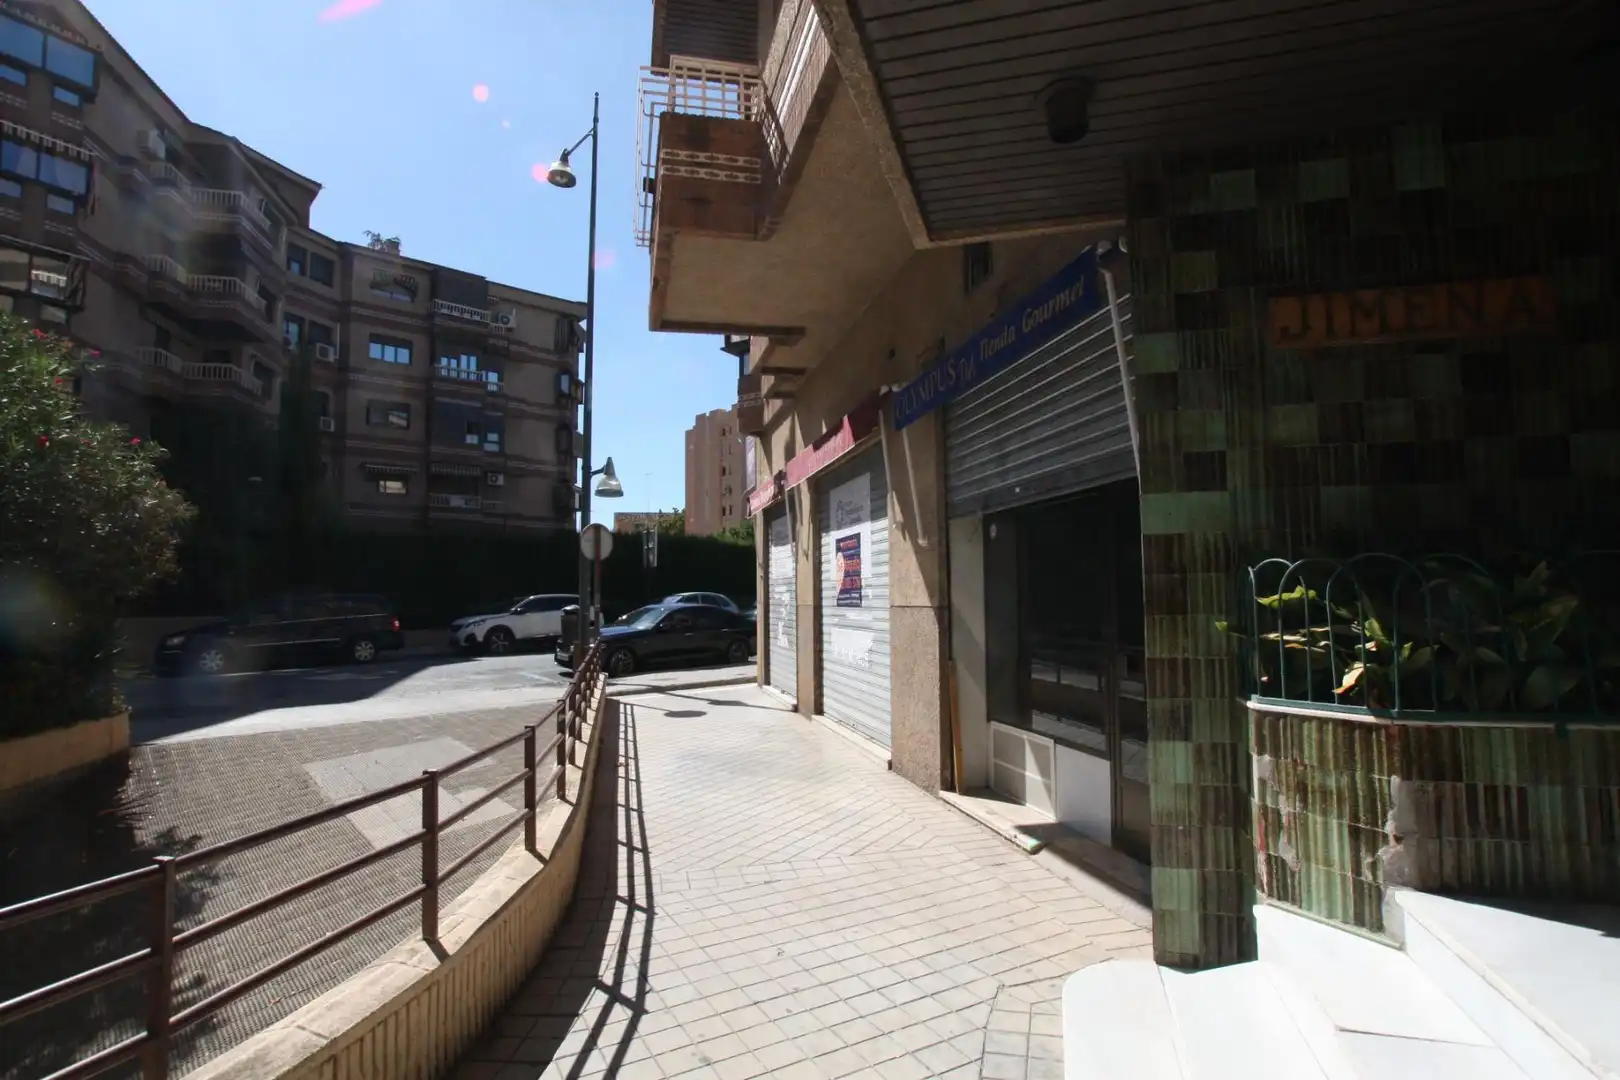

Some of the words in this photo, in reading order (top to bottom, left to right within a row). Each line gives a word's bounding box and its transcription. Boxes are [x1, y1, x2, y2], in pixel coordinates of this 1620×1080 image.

[896, 357, 957, 419] OLYMPUS
[980, 323, 1016, 361] Tienda
[1022, 274, 1084, 333] Gourmet
[1274, 279, 1545, 343] JIMENA
